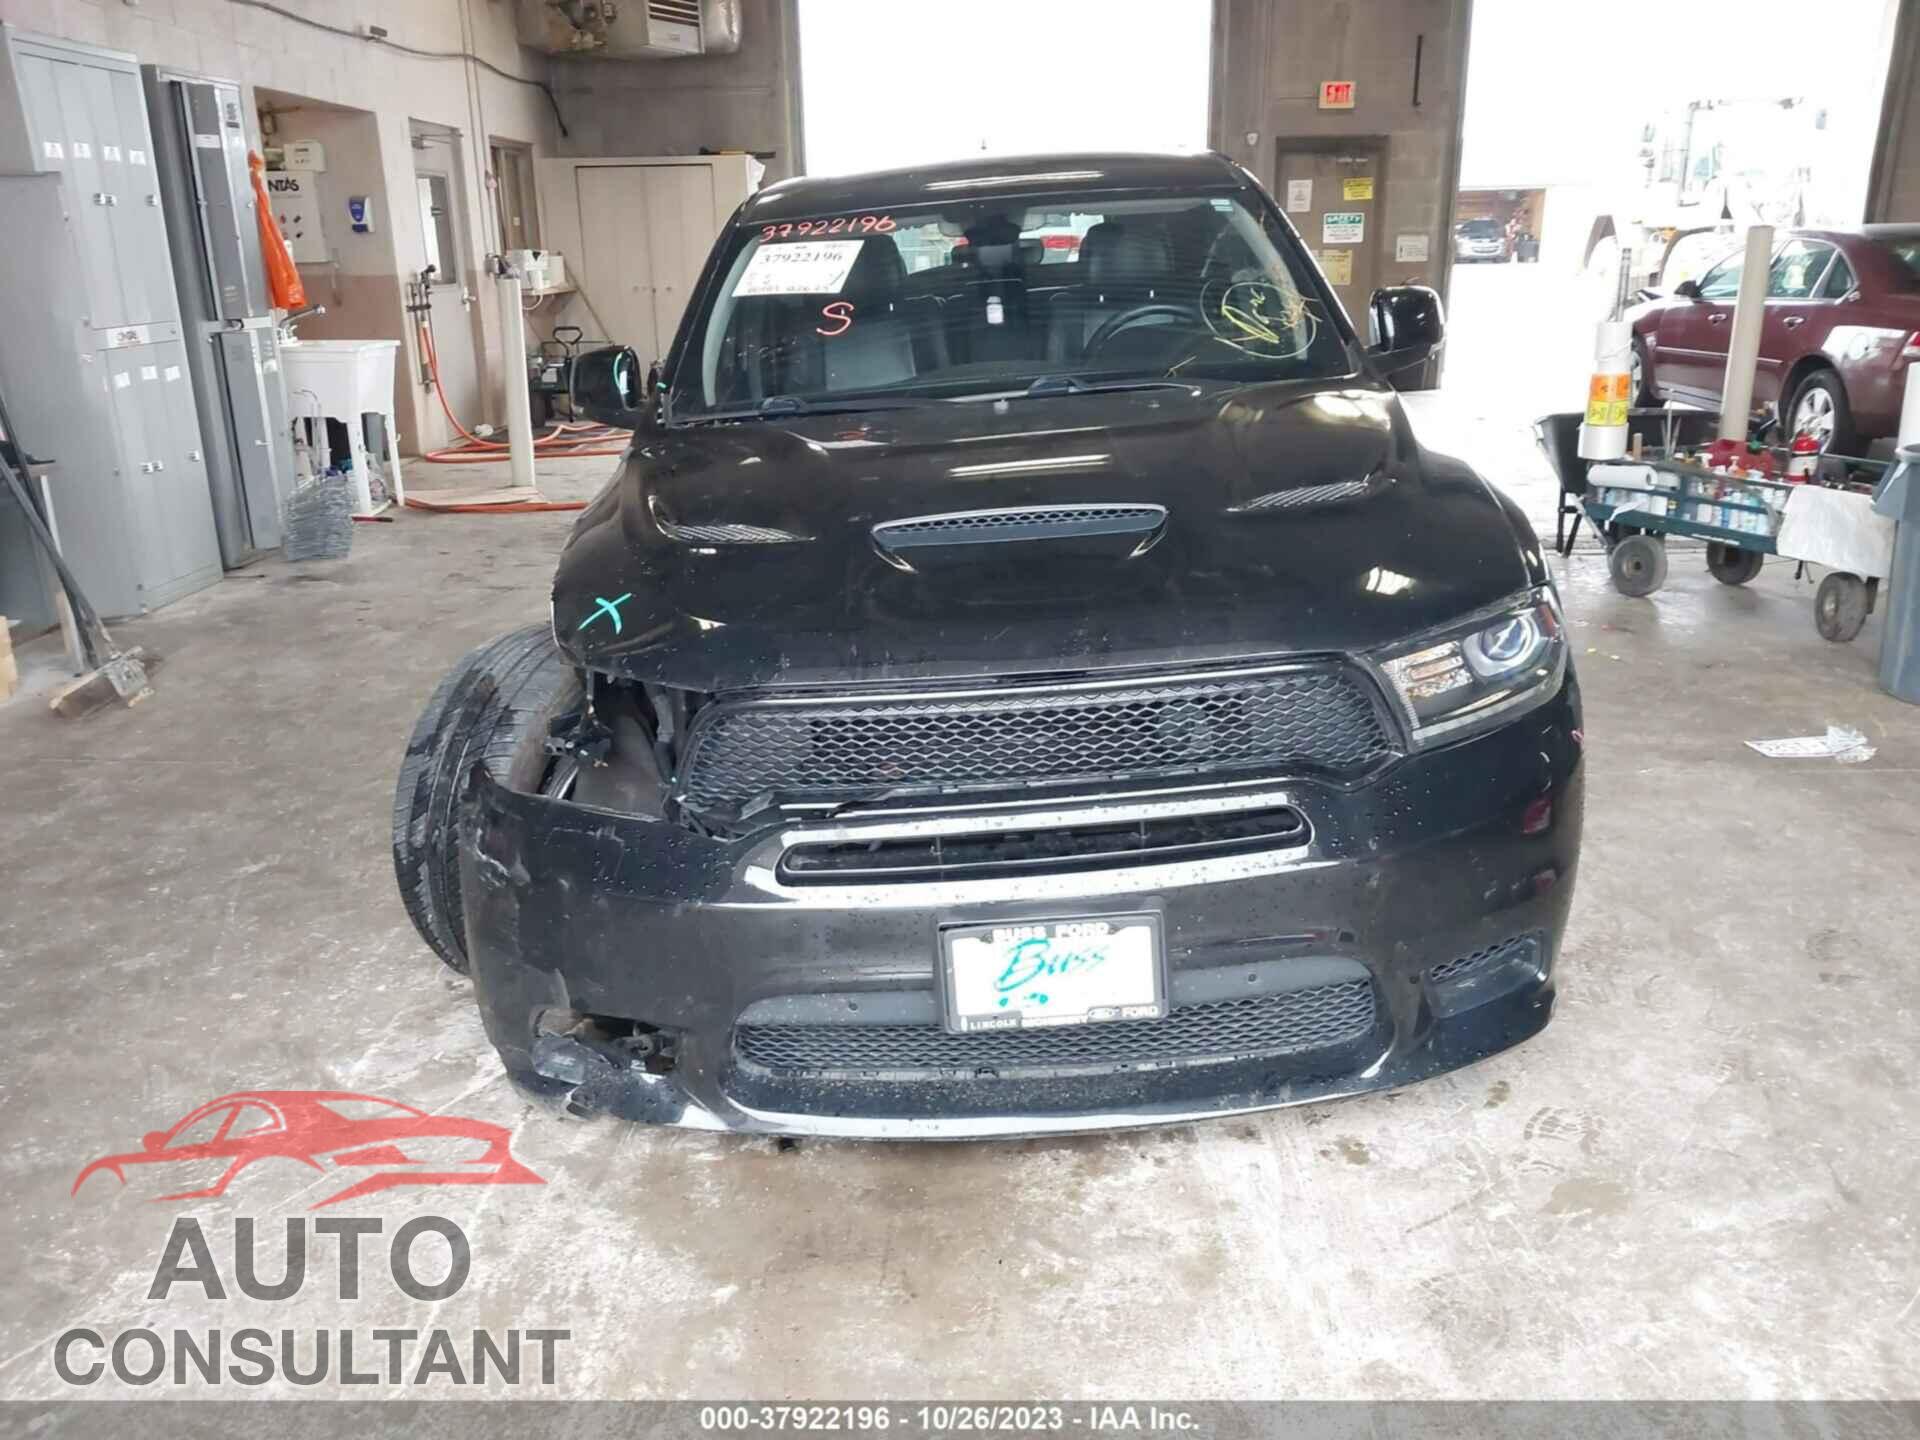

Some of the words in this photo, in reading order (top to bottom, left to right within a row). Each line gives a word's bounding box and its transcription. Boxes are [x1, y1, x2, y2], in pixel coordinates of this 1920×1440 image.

[1326, 84, 1352, 104] EXIT
[758, 215, 897, 243] 37922196
[816, 302, 855, 335] S
